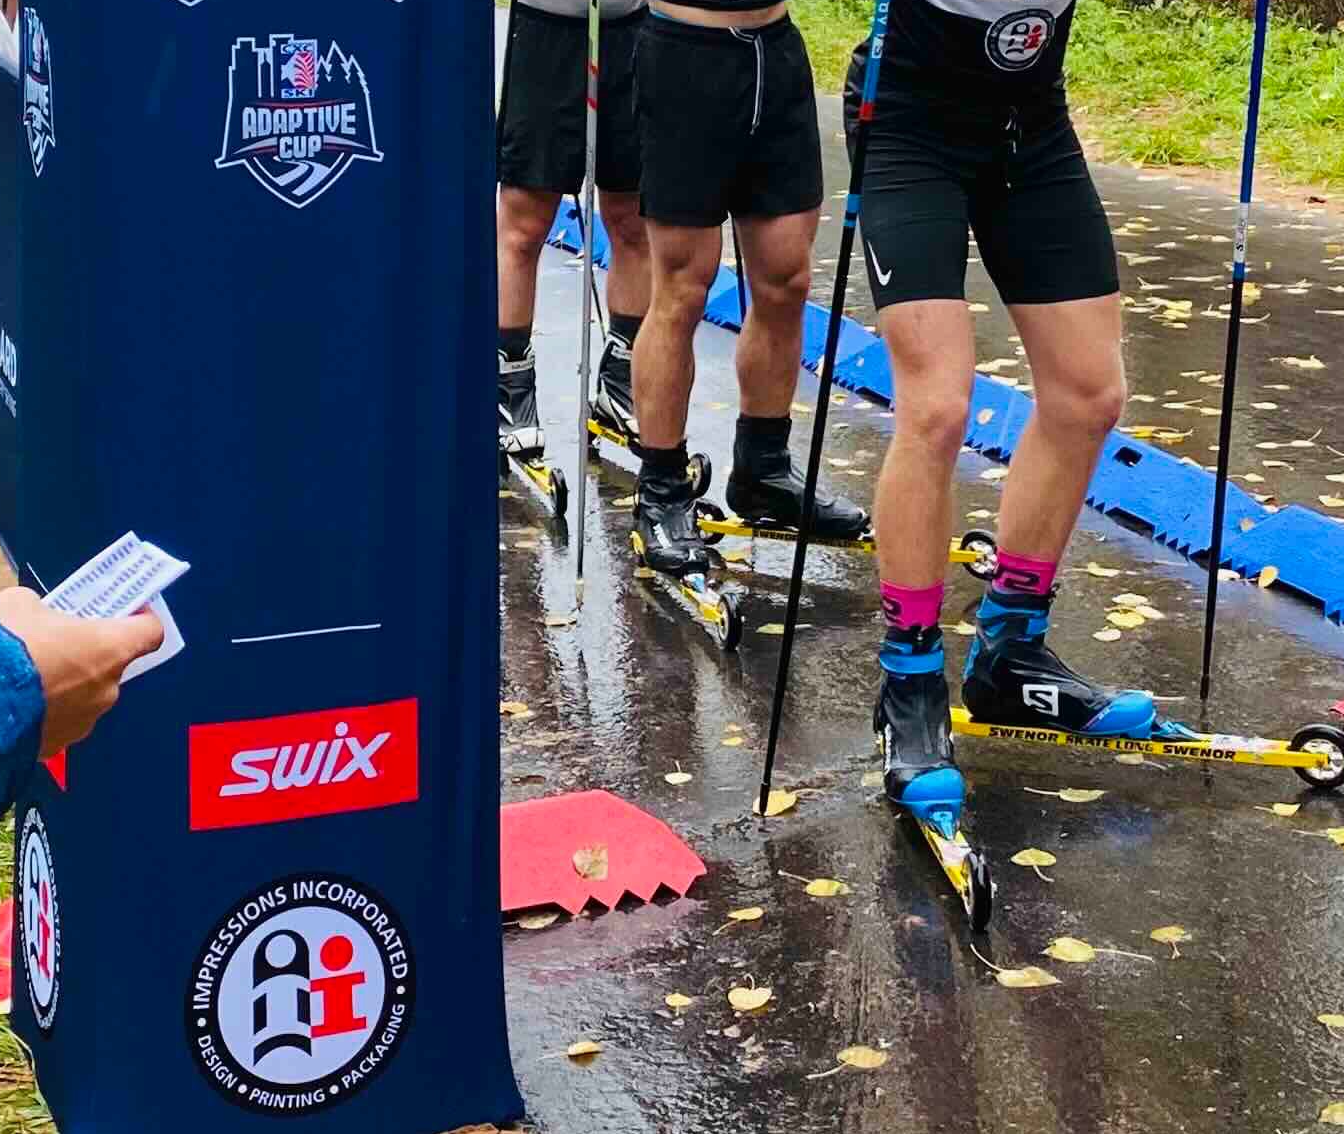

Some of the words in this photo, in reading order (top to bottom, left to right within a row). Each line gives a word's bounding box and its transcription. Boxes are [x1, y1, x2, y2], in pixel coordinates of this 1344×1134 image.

[242, 103, 356, 139] ADAPTIVE
[280, 135, 322, 159] CUP
[989, 727, 1058, 742] SWENOR
[1163, 745, 1236, 760] SWENOR
[193, 886, 287, 1010] IMPRESSIONS
[293, 880, 408, 979] INCORPORATED
[198, 1034, 238, 1089] DESIGN
[249, 1088, 326, 1108] PRINTING
[341, 1003, 405, 1089] PACKAGING
